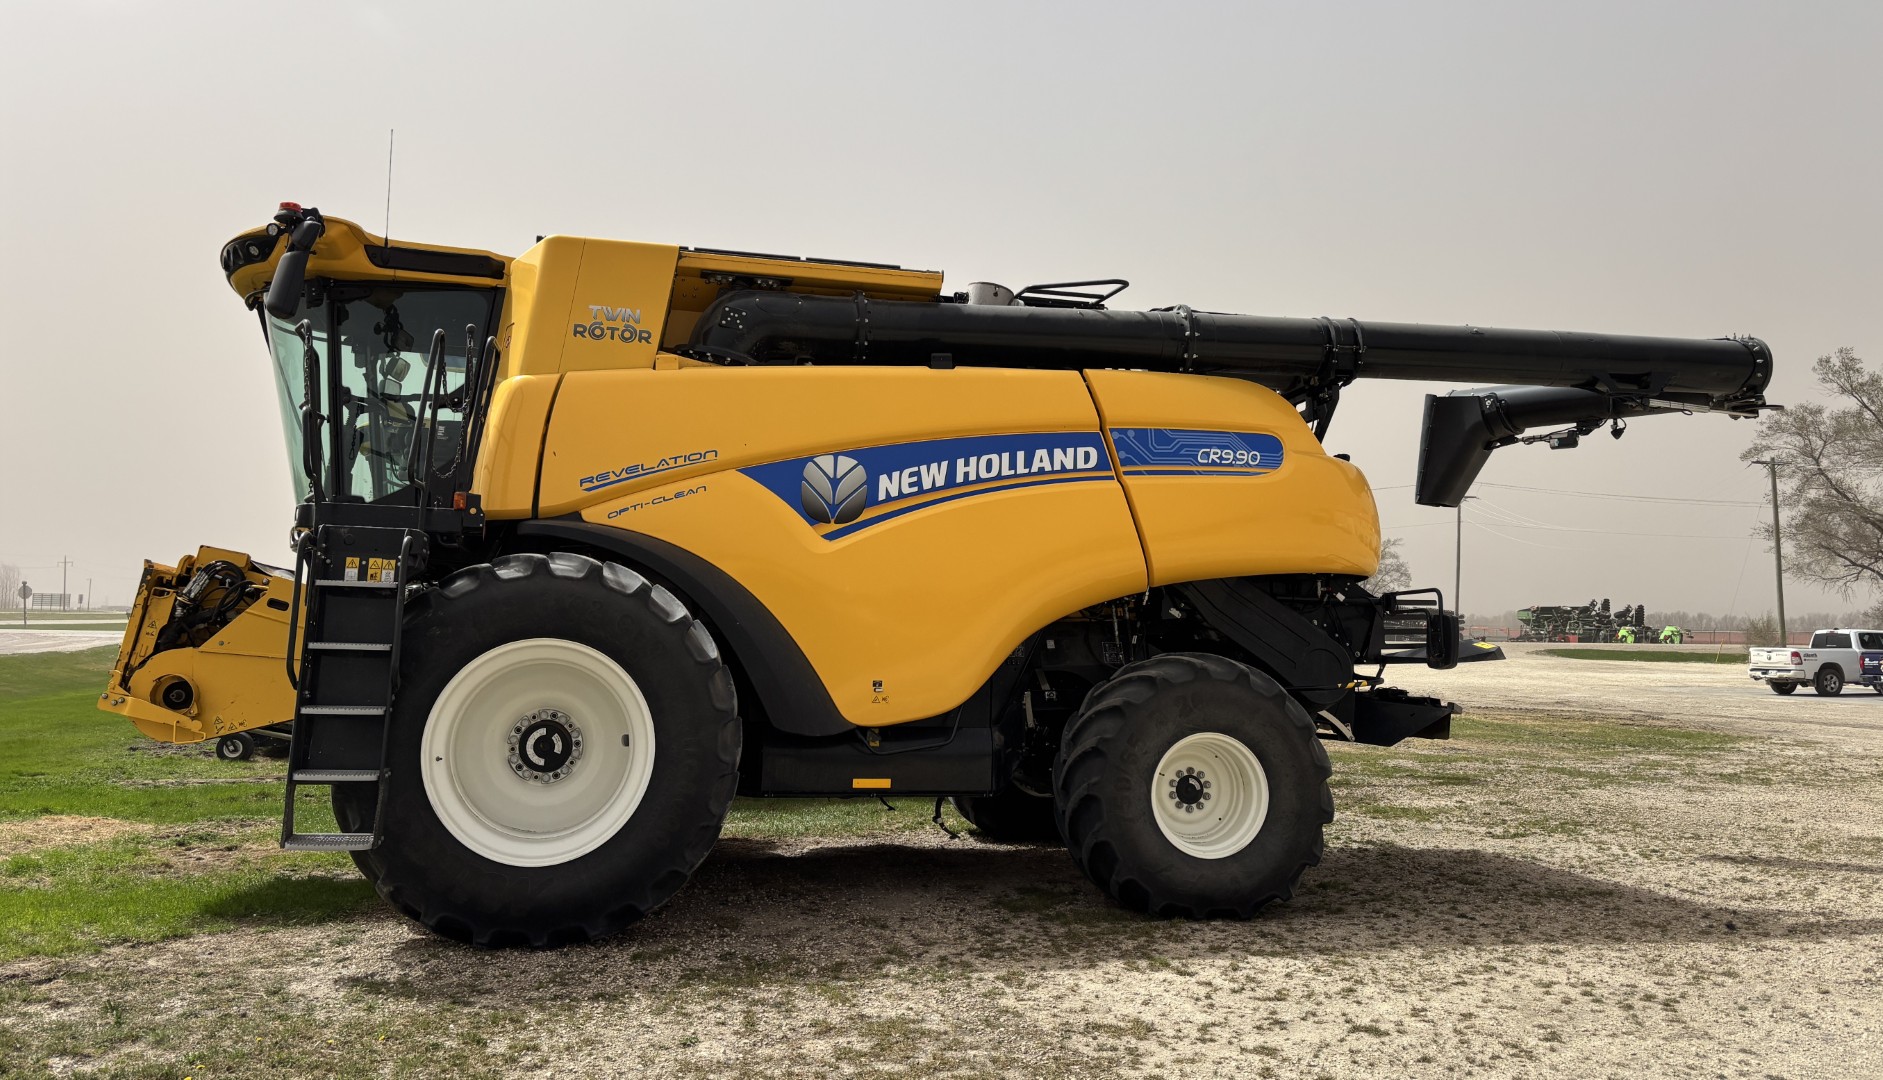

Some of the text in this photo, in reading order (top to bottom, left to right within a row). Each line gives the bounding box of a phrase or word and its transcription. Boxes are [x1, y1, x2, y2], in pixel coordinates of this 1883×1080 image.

[588, 305, 641, 324] TWIN
[573, 321, 653, 344] ROTOR
[579, 449, 718, 487] REVELATION
[1197, 448, 1260, 465] CR9.90
[878, 446, 1098, 502] NEW HOLLAND
[607, 485, 707, 519] OPTI-CLEAN
